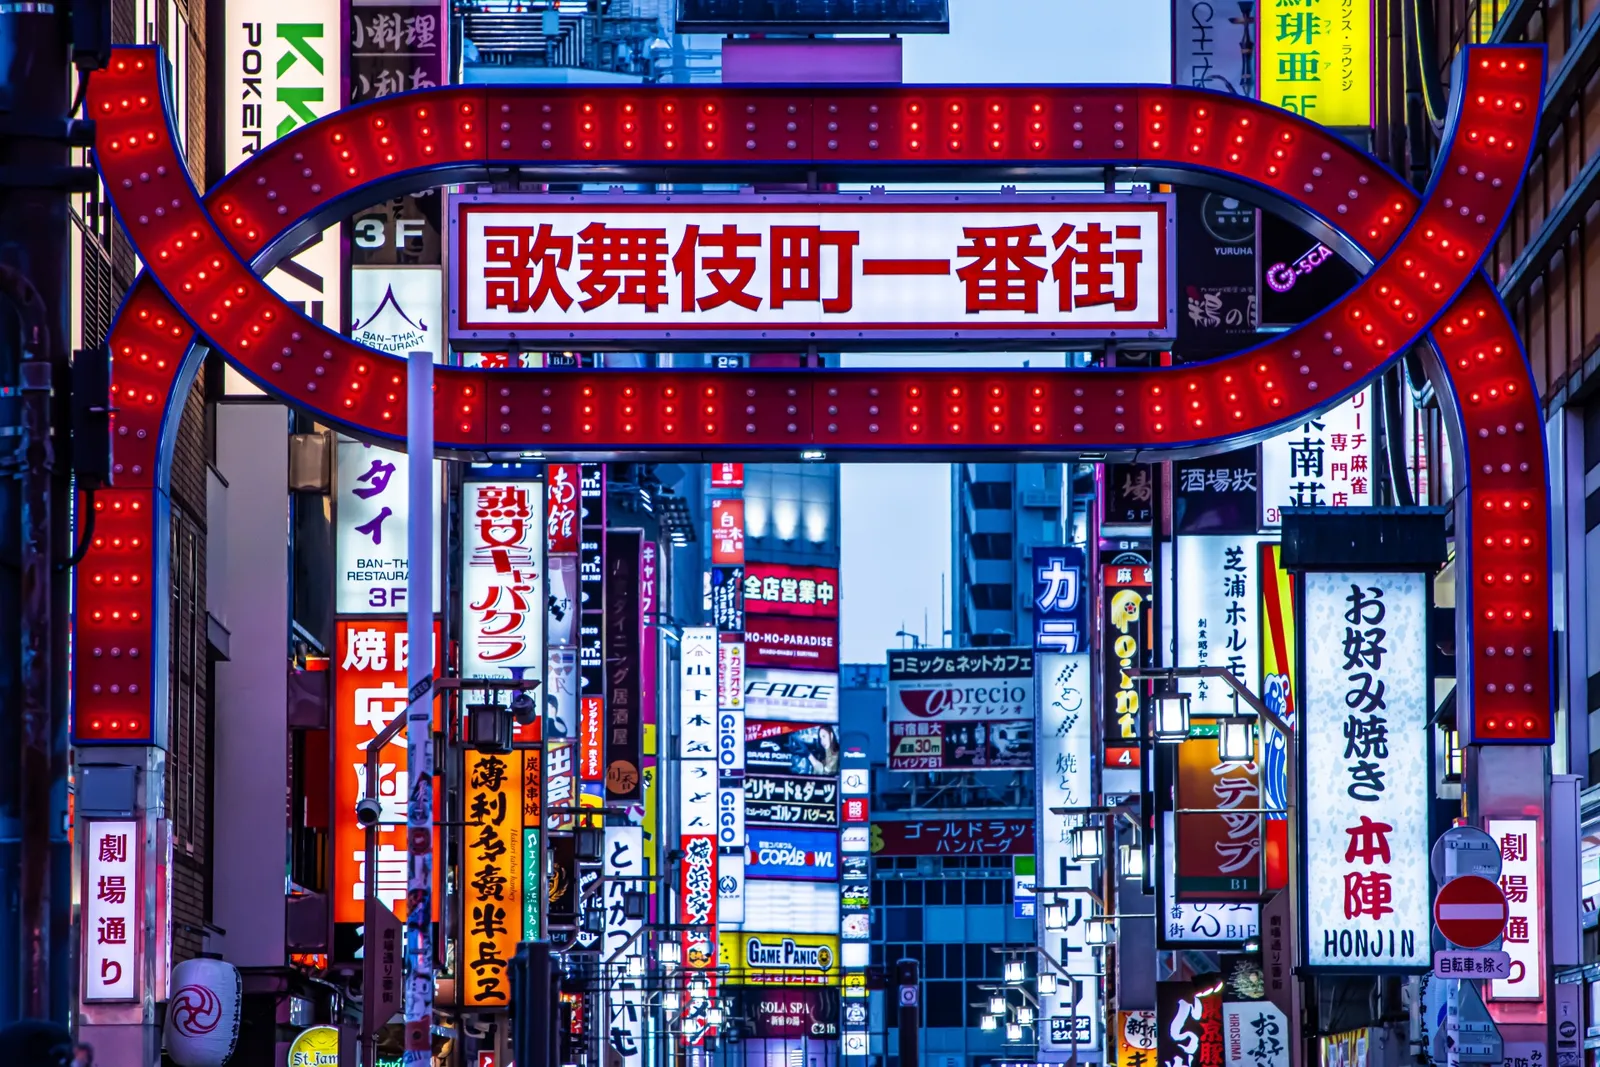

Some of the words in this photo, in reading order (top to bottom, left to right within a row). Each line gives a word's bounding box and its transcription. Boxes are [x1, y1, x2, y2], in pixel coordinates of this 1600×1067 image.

[352, 12, 437, 51] 小料理
[1276, 0, 1321, 82] 琲亜
[241, 22, 262, 155] POKER
[355, 219, 426, 248] 3F
[483, 221, 1143, 314] 歌舞伎町一番街
[362, 330, 417, 343] BAN-THAI
[1350, 392, 1368, 495] リーチ麻雀
[1330, 433, 1348, 506] 専門店
[352, 460, 397, 545] タイ
[347, 571, 410, 581] RESTAURA
[357, 558, 409, 569] BAN-TH
[369, 587, 408, 608] 3F
[744, 576, 834, 605] 全店営業中
[1037, 557, 1081, 654] カラ
[1223, 545, 1248, 699] 芝浦ホルモ
[731, 656, 741, 697] カラオケ
[892, 655, 1032, 674] コミック&ネットカフェ
[1197, 617, 1209, 701] 創業昭和二九年
[744, 681, 835, 701] FACE
[925, 680, 1026, 715] aprecio
[1342, 583, 1388, 802] お好み焼き
[958, 705, 1024, 716] アプレシオ
[720, 714, 735, 766] GiGO
[1118, 749, 1132, 766] 4
[523, 756, 541, 817] 炭火串焼
[743, 778, 836, 803] ビリヤード&ダーツ
[720, 791, 735, 844] GiGO
[904, 822, 1035, 839] ゴールドラッ
[935, 839, 1013, 853] ハンバーグ
[1342, 815, 1394, 921] 本陣
[97, 833, 127, 986] 劇場通り
[1500, 832, 1529, 984] 劇場通り
[1226, 924, 1257, 939] B1F
[1324, 929, 1415, 959] HONJIN
[749, 940, 781, 964] GAME
[784, 941, 817, 966] PANIC
[1440, 957, 1504, 973] 自転車を除く
[760, 1002, 788, 1014] SOLA
[790, 1002, 810, 1014] SPA
[1229, 1013, 1242, 1062] HIROSHIMA
